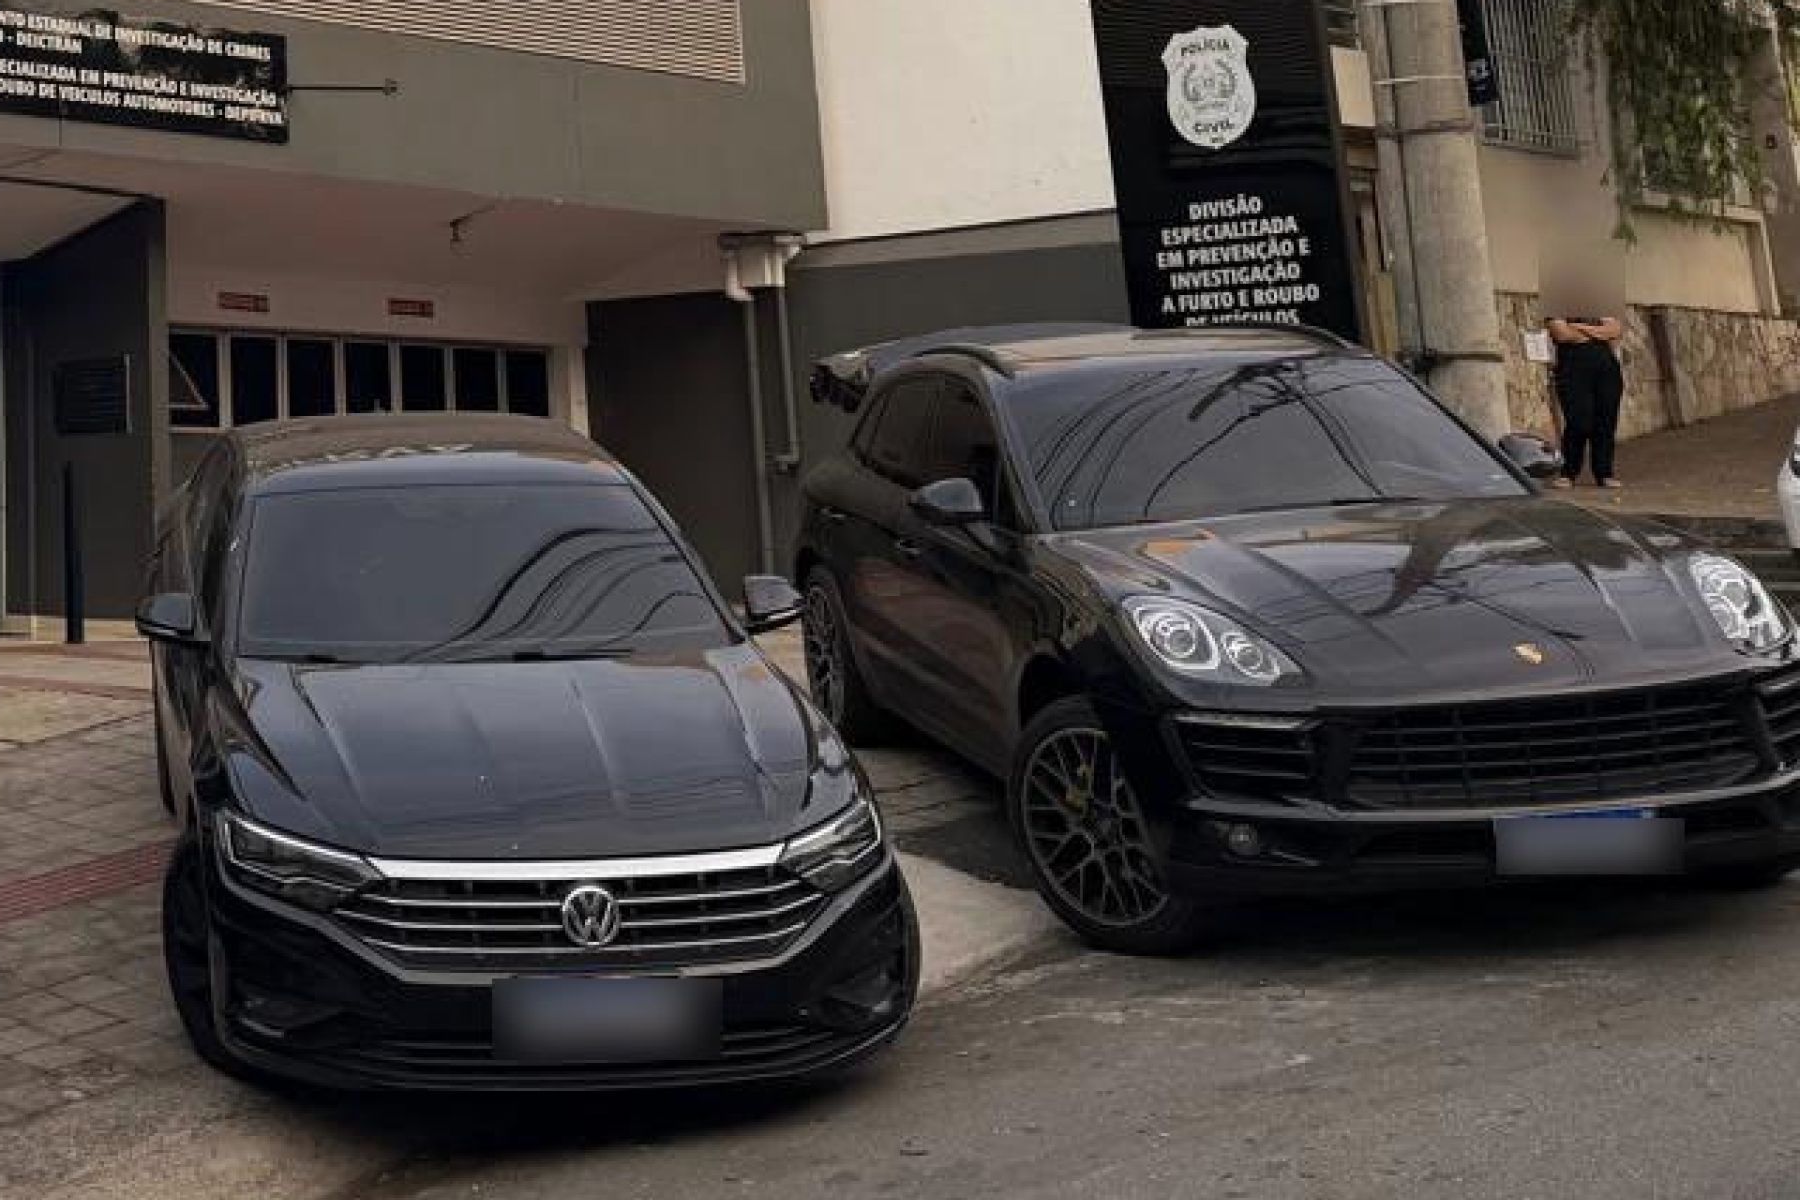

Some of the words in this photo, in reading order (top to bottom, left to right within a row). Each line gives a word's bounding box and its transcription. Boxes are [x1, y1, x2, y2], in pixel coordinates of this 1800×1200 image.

[28, 13, 93, 38] ESTADUAL
[94, 24, 112, 40] DE
[207, 38, 223, 54] DE
[80, 69, 100, 85] EM
[103, 71, 178, 95] PREVENÇÃO
[179, 80, 188, 96] E
[38, 83, 57, 99] DE
[123, 91, 215, 119] AUTOMOTORES
[1188, 193, 1262, 220] DIVISÃO
[1161, 216, 1299, 246] ESPECIALIZADA
[1157, 250, 1185, 268] EM
[1186, 236, 1295, 266] PREVENÇÃO
[1298, 237, 1312, 256] E
[1169, 260, 1301, 291] INVESTIGAÇÃO
[1161, 294, 1176, 313] A
[1178, 291, 1234, 313] FURTO
[1237, 288, 1250, 307] E
[1252, 283, 1320, 307] ROUBO
